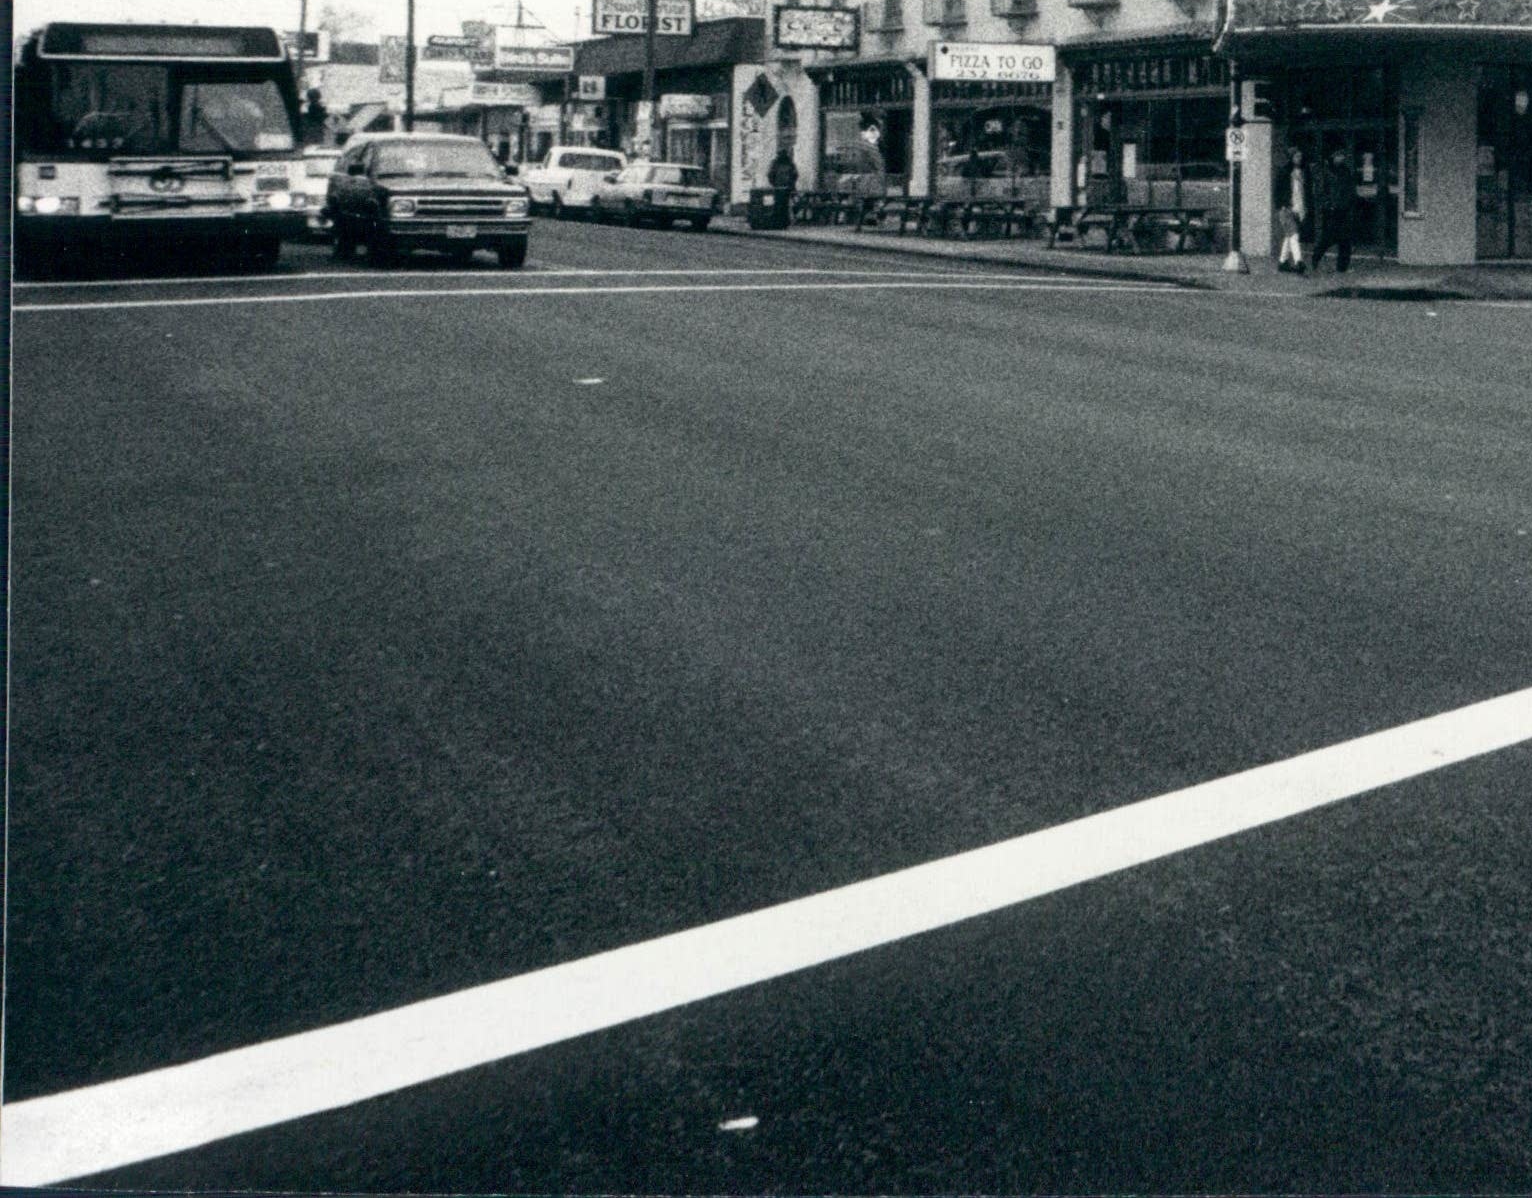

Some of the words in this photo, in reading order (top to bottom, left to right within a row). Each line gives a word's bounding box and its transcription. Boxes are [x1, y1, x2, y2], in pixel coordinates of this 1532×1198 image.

[602, 14, 687, 32] FLOST
[950, 54, 990, 69] PIZZA
[997, 55, 1016, 70] TO
[1022, 56, 1044, 70] GO
